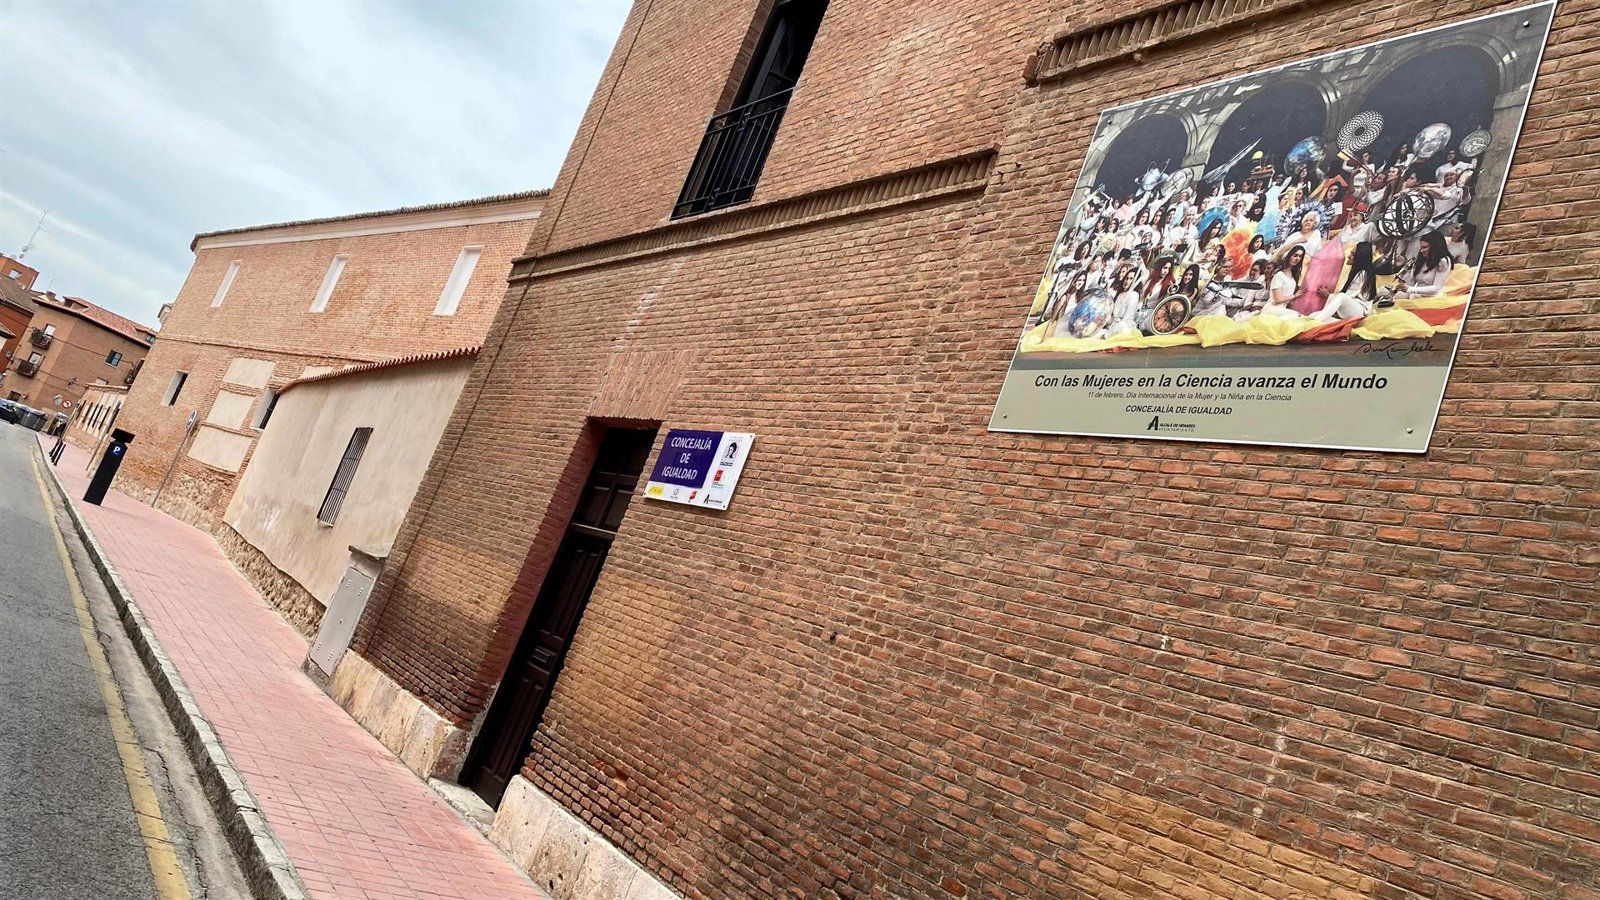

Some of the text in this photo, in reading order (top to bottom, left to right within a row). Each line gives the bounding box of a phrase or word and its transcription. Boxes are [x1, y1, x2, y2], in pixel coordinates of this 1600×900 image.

[1034, 373, 1388, 390] Con las Mujeres en la Ciencia avanza el Mundo
[1138, 391, 1177, 399] Internacional
[1194, 392, 1213, 401] Mujer
[1264, 393, 1292, 401] Ciencia
[1125, 404, 1233, 415] CONCEJALÍA DE IGUALDAD
[670, 436, 712, 451] CONCEJALÍA
[680, 453, 692, 464] DE
[661, 466, 698, 480] IGUALDAD
